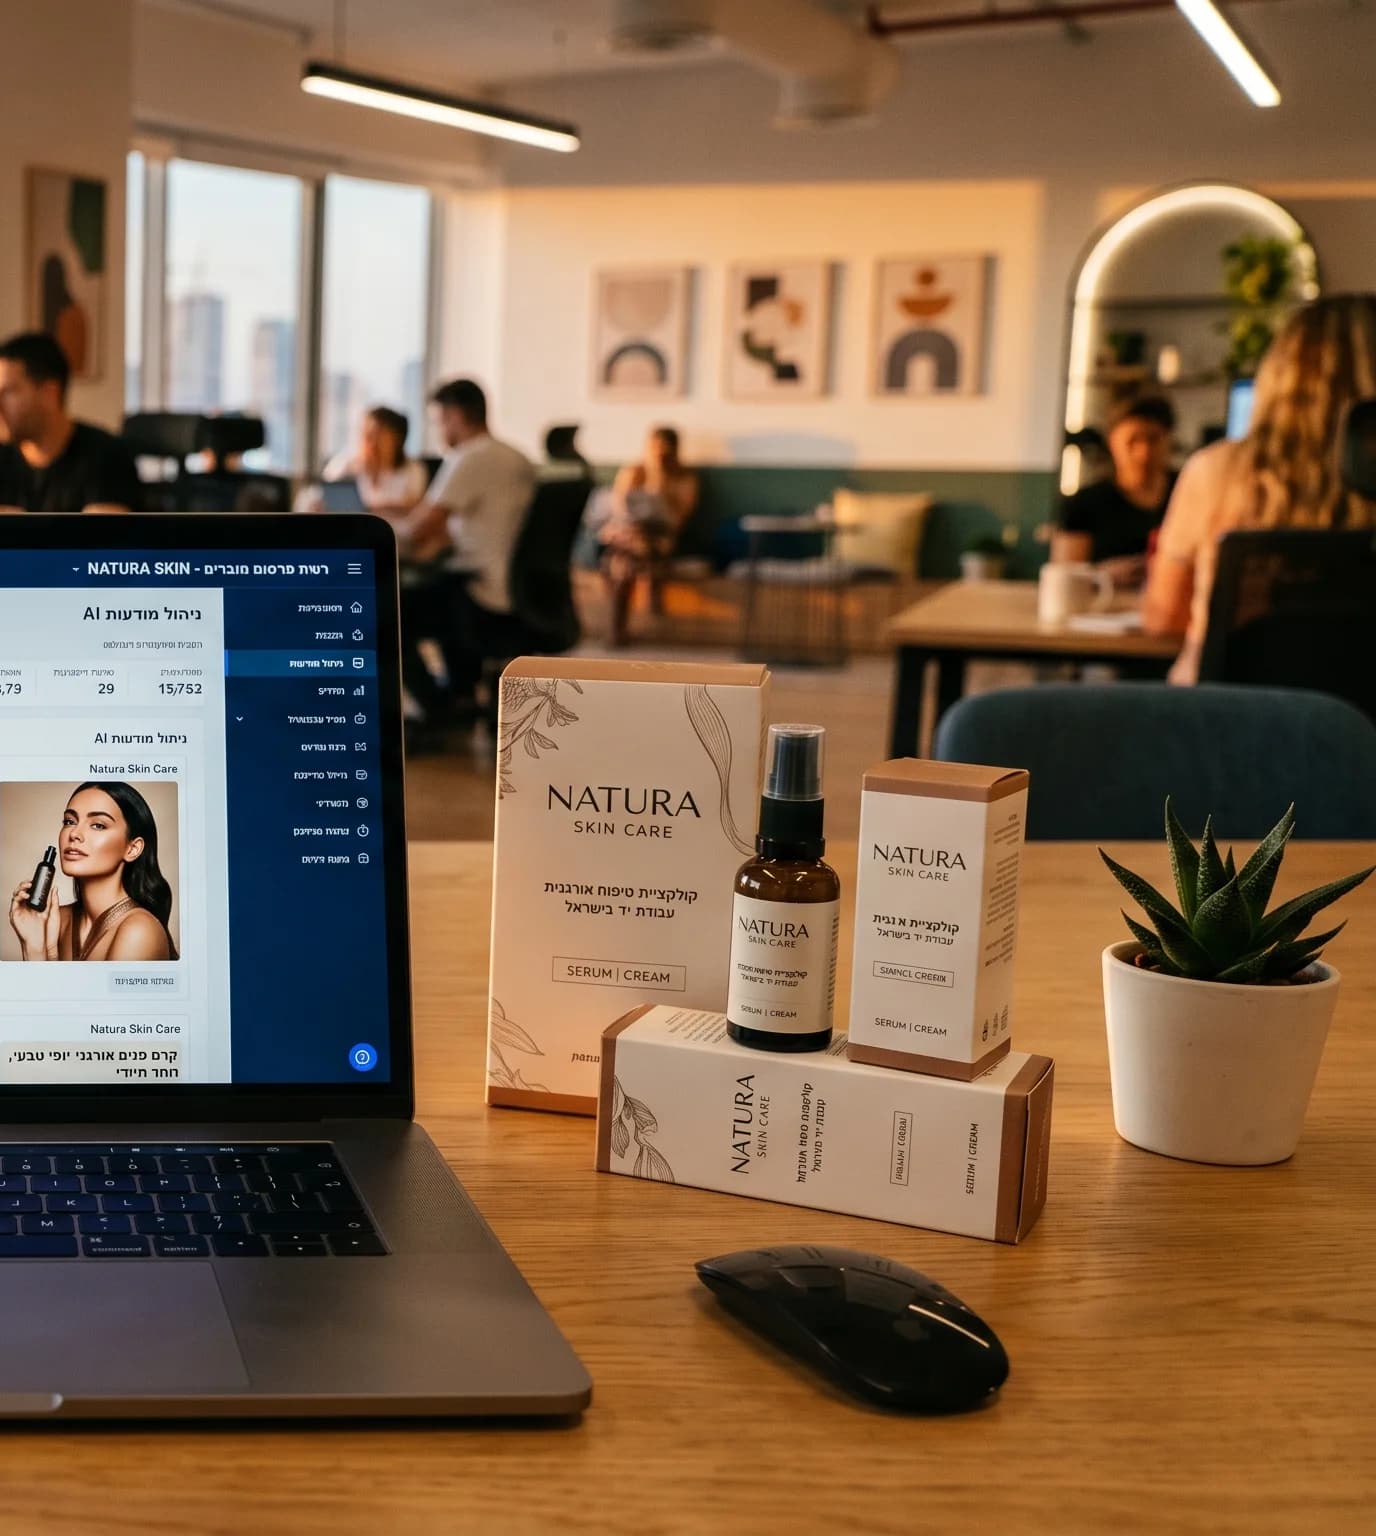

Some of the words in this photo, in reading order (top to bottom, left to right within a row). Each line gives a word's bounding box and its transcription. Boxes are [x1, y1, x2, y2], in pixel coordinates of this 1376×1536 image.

[87, 562, 150, 575] NATURA
[154, 562, 190, 575] SKIN
[83, 606, 100, 621] AI
[105, 608, 159, 621] מודעות
[164, 606, 202, 621] ניהול
[98, 683, 115, 695] 29
[94, 732, 107, 744] AI
[89, 764, 125, 774] Natura
[127, 764, 151, 774] Skin
[153, 764, 178, 774] Care
[548, 784, 701, 818] NATURA
[574, 820, 615, 835] SKIN
[624, 823, 673, 839] CARE
[873, 843, 967, 871] NATURA
[888, 866, 914, 878] SKIN
[918, 869, 950, 882] CARE
[544, 882, 593, 896] אורגנית
[597, 884, 634, 898] טיפוח
[638, 888, 698, 905] קולקציית
[564, 900, 613, 915] בישראל
[618, 905, 631, 916] יד
[635, 906, 675, 919] עבודת
[739, 915, 809, 939] NATURA
[909, 918, 960, 936] קולקציית
[769, 938, 797, 949] CARE
[913, 933, 922, 942] יד
[567, 965, 612, 979] SERUM
[623, 969, 670, 983] CREAM
[770, 1009, 797, 1018] CREAM
[90, 1024, 126, 1034] Natura
[129, 1024, 153, 1034] Skin
[155, 1024, 181, 1034] Care
[874, 1017, 907, 1030] SERUM
[914, 1024, 947, 1037] CREAM
[48, 1051, 70, 1061] יופי
[75, 1051, 115, 1061] אורגני
[118, 1051, 148, 1061] פנים
[151, 1051, 178, 1063] קרם
[758, 1095, 770, 1127] CARE
[730, 1074, 755, 1175] NATURA
